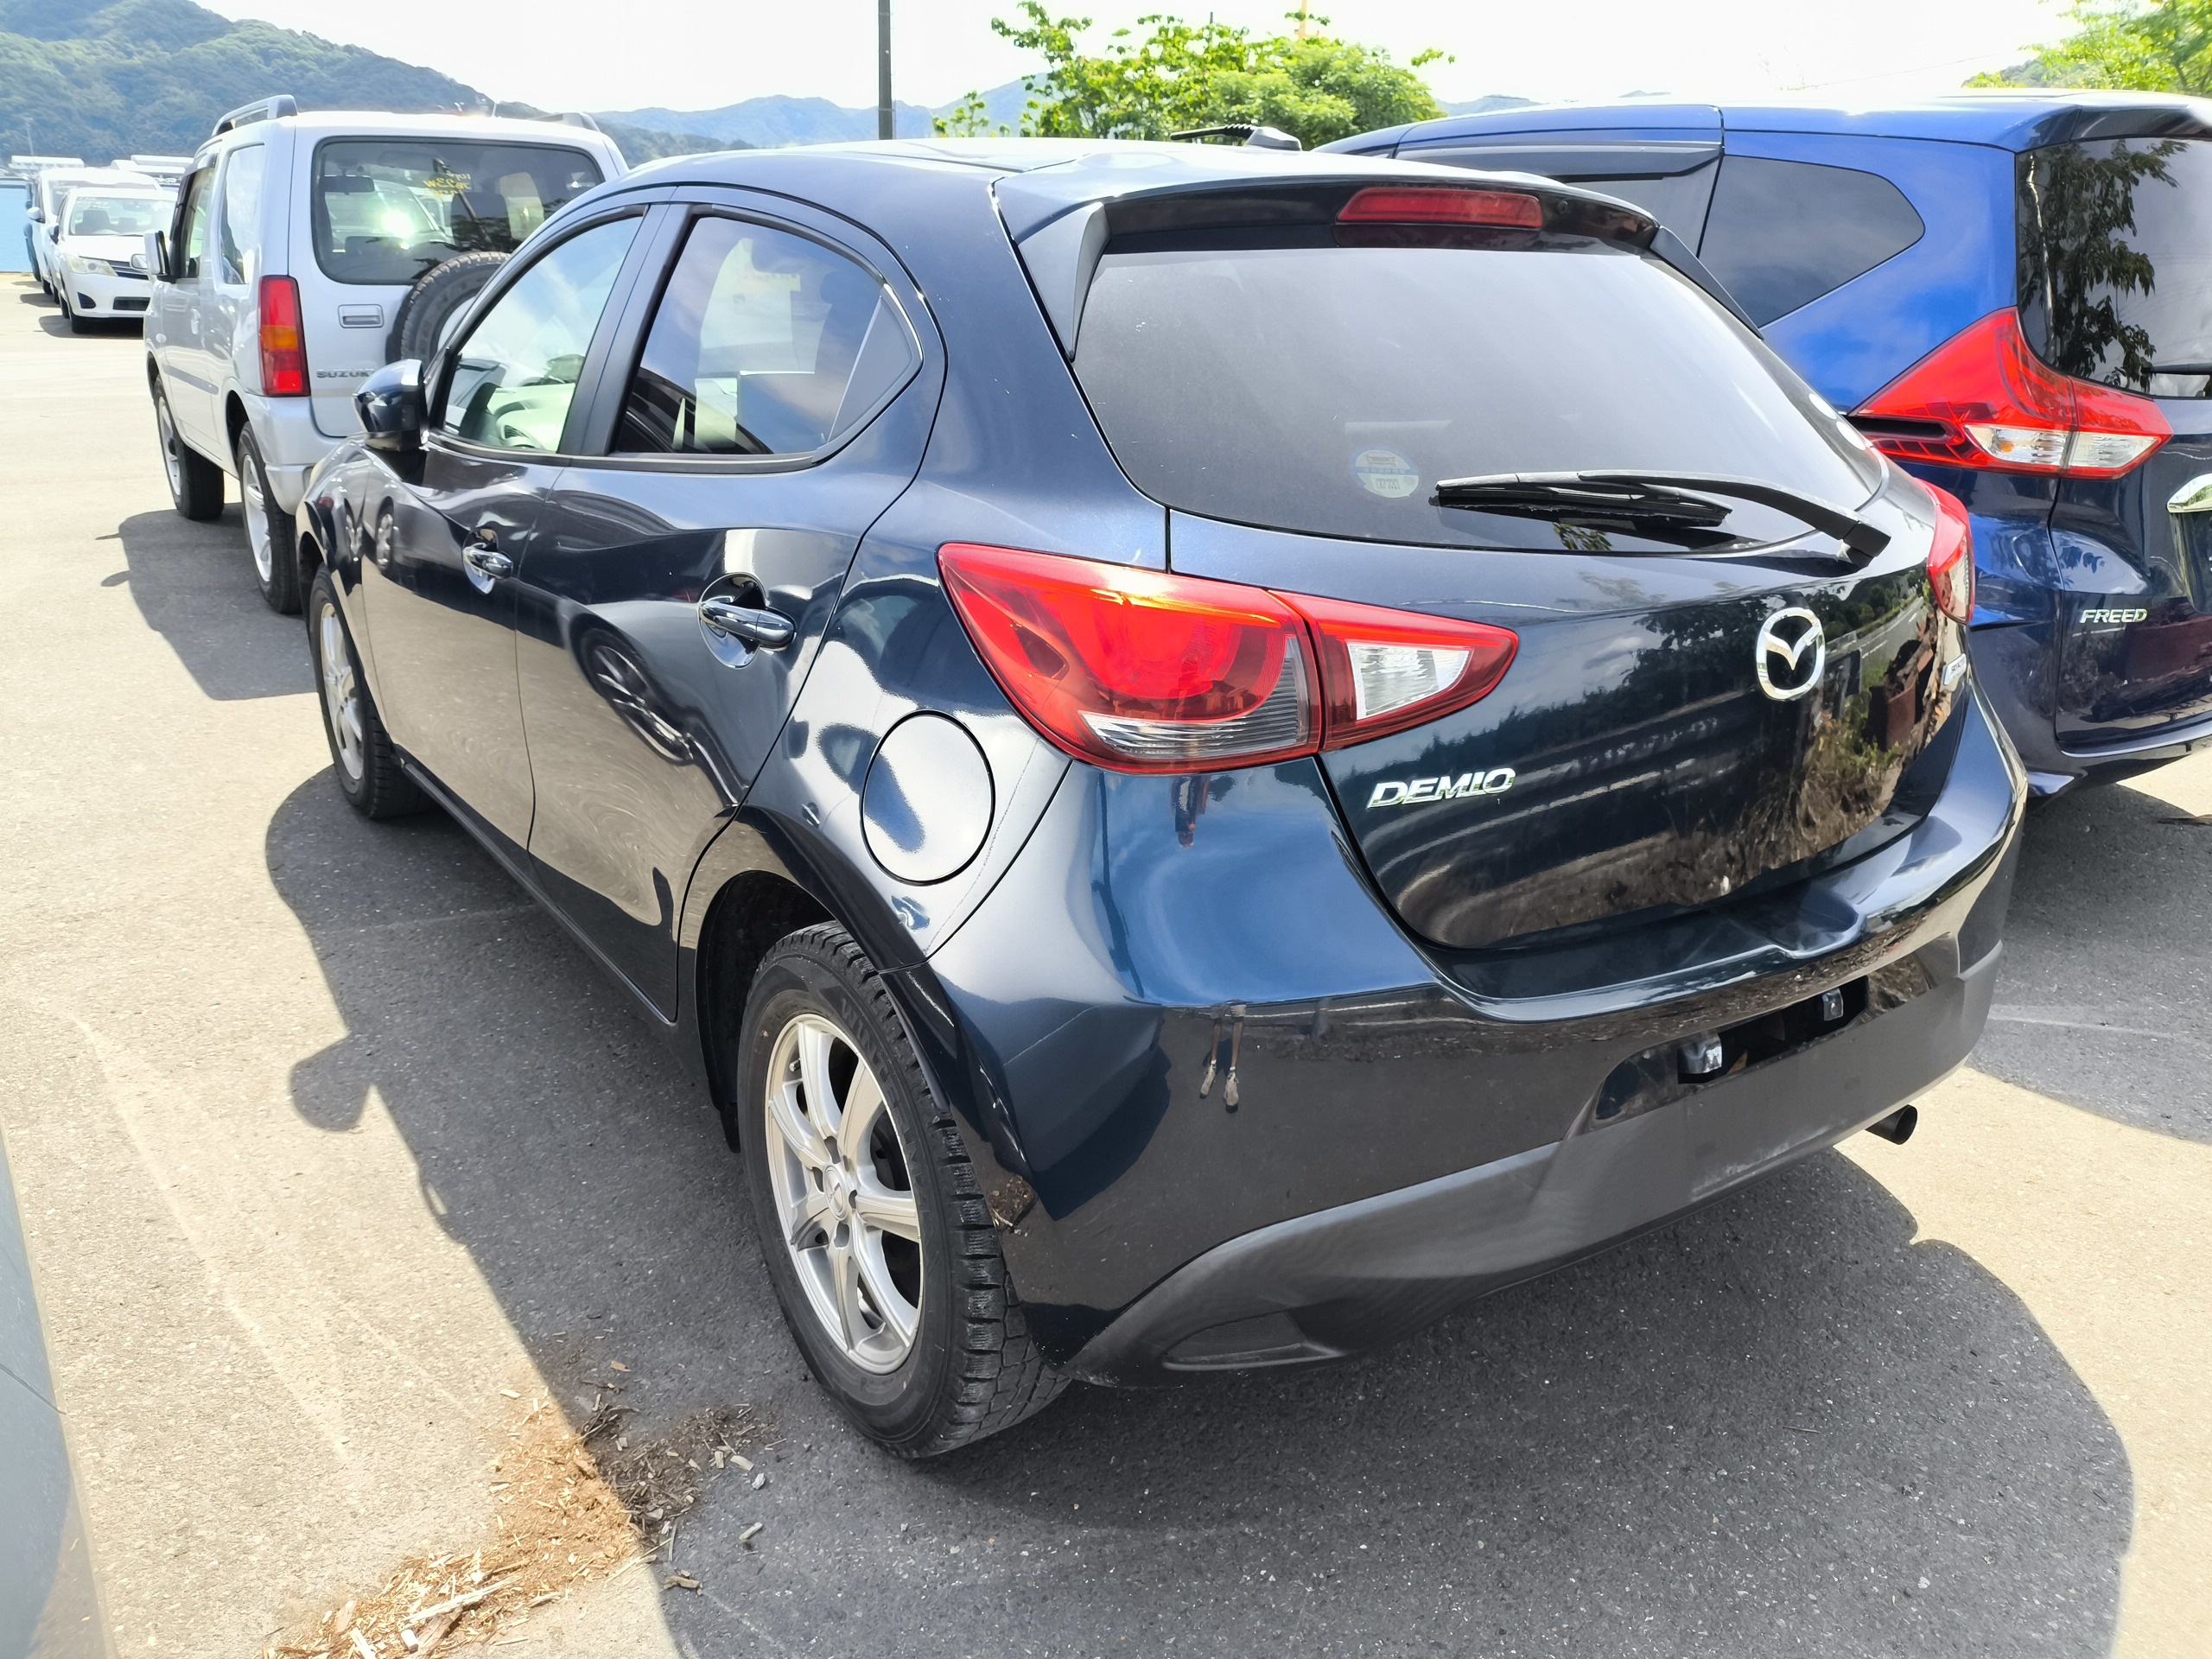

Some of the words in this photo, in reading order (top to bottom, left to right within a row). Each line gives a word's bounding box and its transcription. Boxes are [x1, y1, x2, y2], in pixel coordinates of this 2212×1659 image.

[316, 368, 375, 378] SUZUK
[2079, 608, 2148, 624] FREED
[1365, 767, 1516, 810] DEMIO
